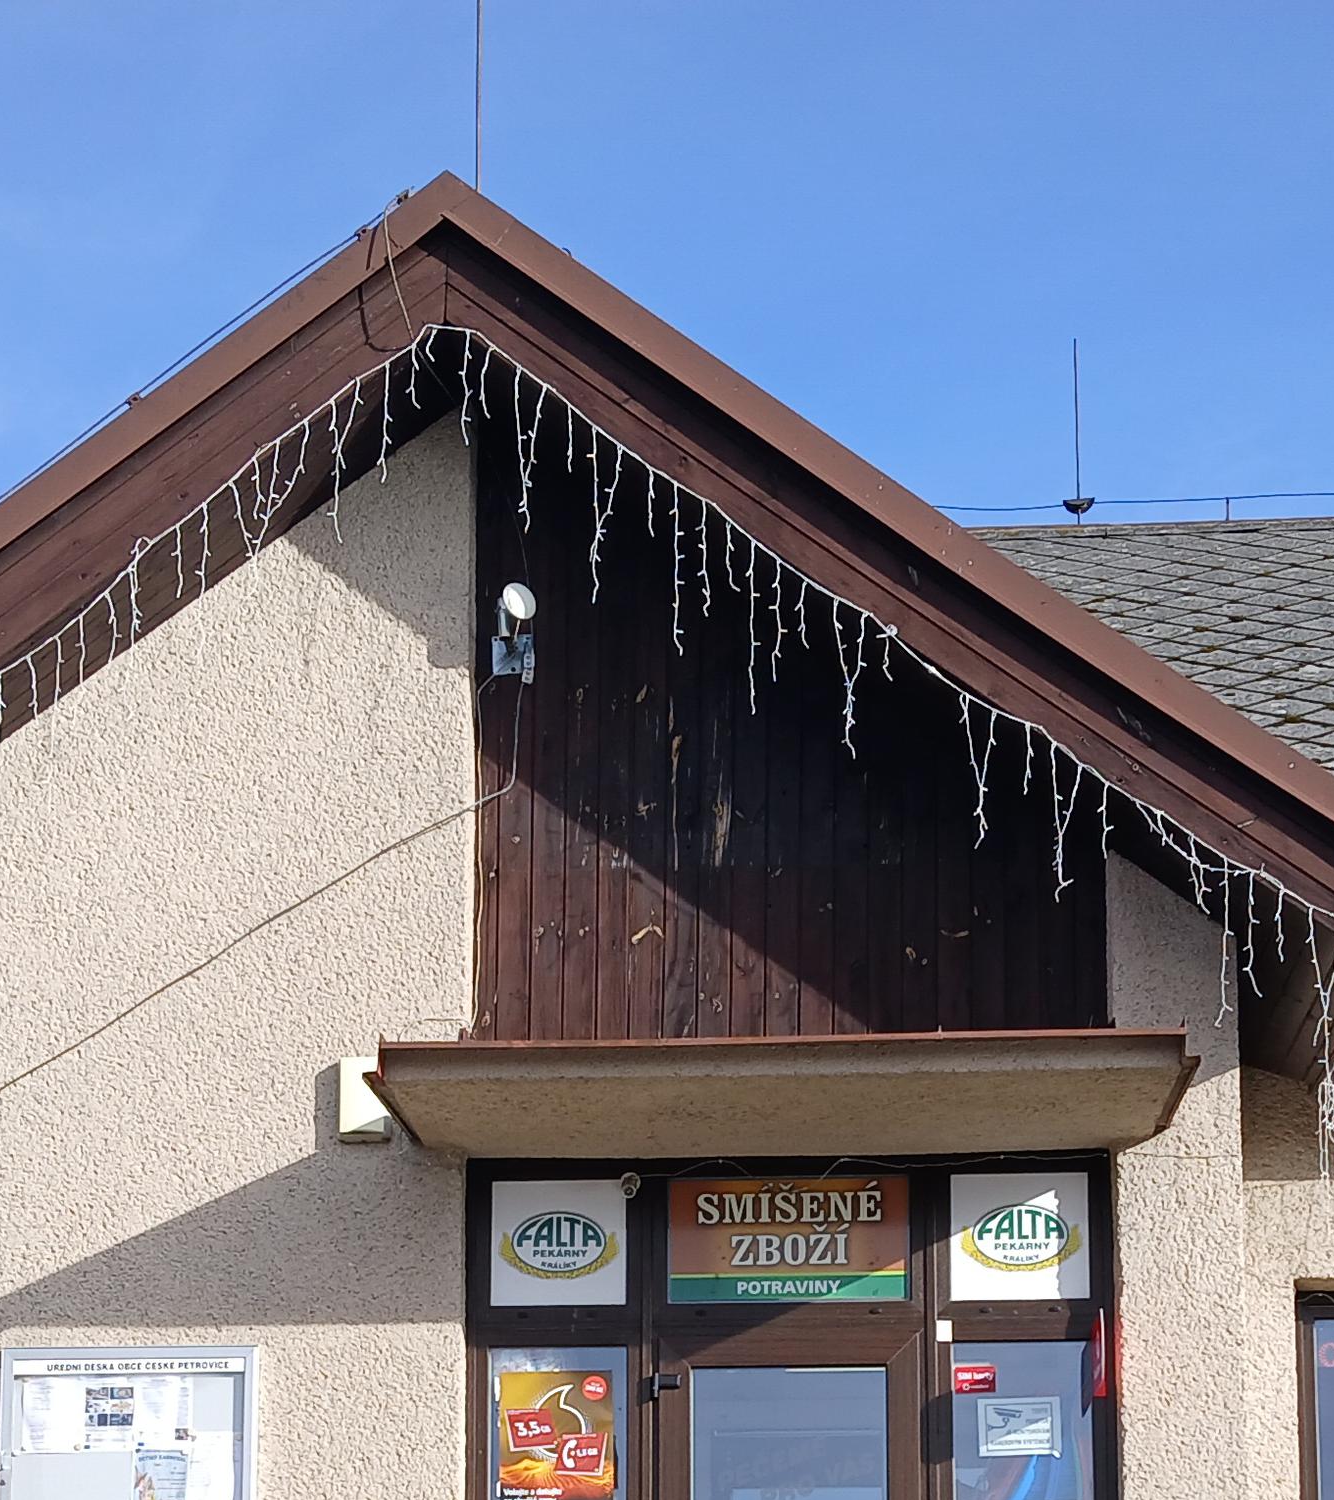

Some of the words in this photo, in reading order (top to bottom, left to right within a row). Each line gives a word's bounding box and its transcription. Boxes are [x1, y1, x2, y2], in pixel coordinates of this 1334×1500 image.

[697, 1180, 882, 1225] SMÍŠENÉ
[517, 1216, 602, 1247] FALTA
[977, 1209, 1064, 1240] FALTA
[533, 1248, 587, 1257] PEKÁRNY
[731, 1223, 850, 1266] ZBOŽÍ
[737, 1280, 841, 1295] POTRAVINY
